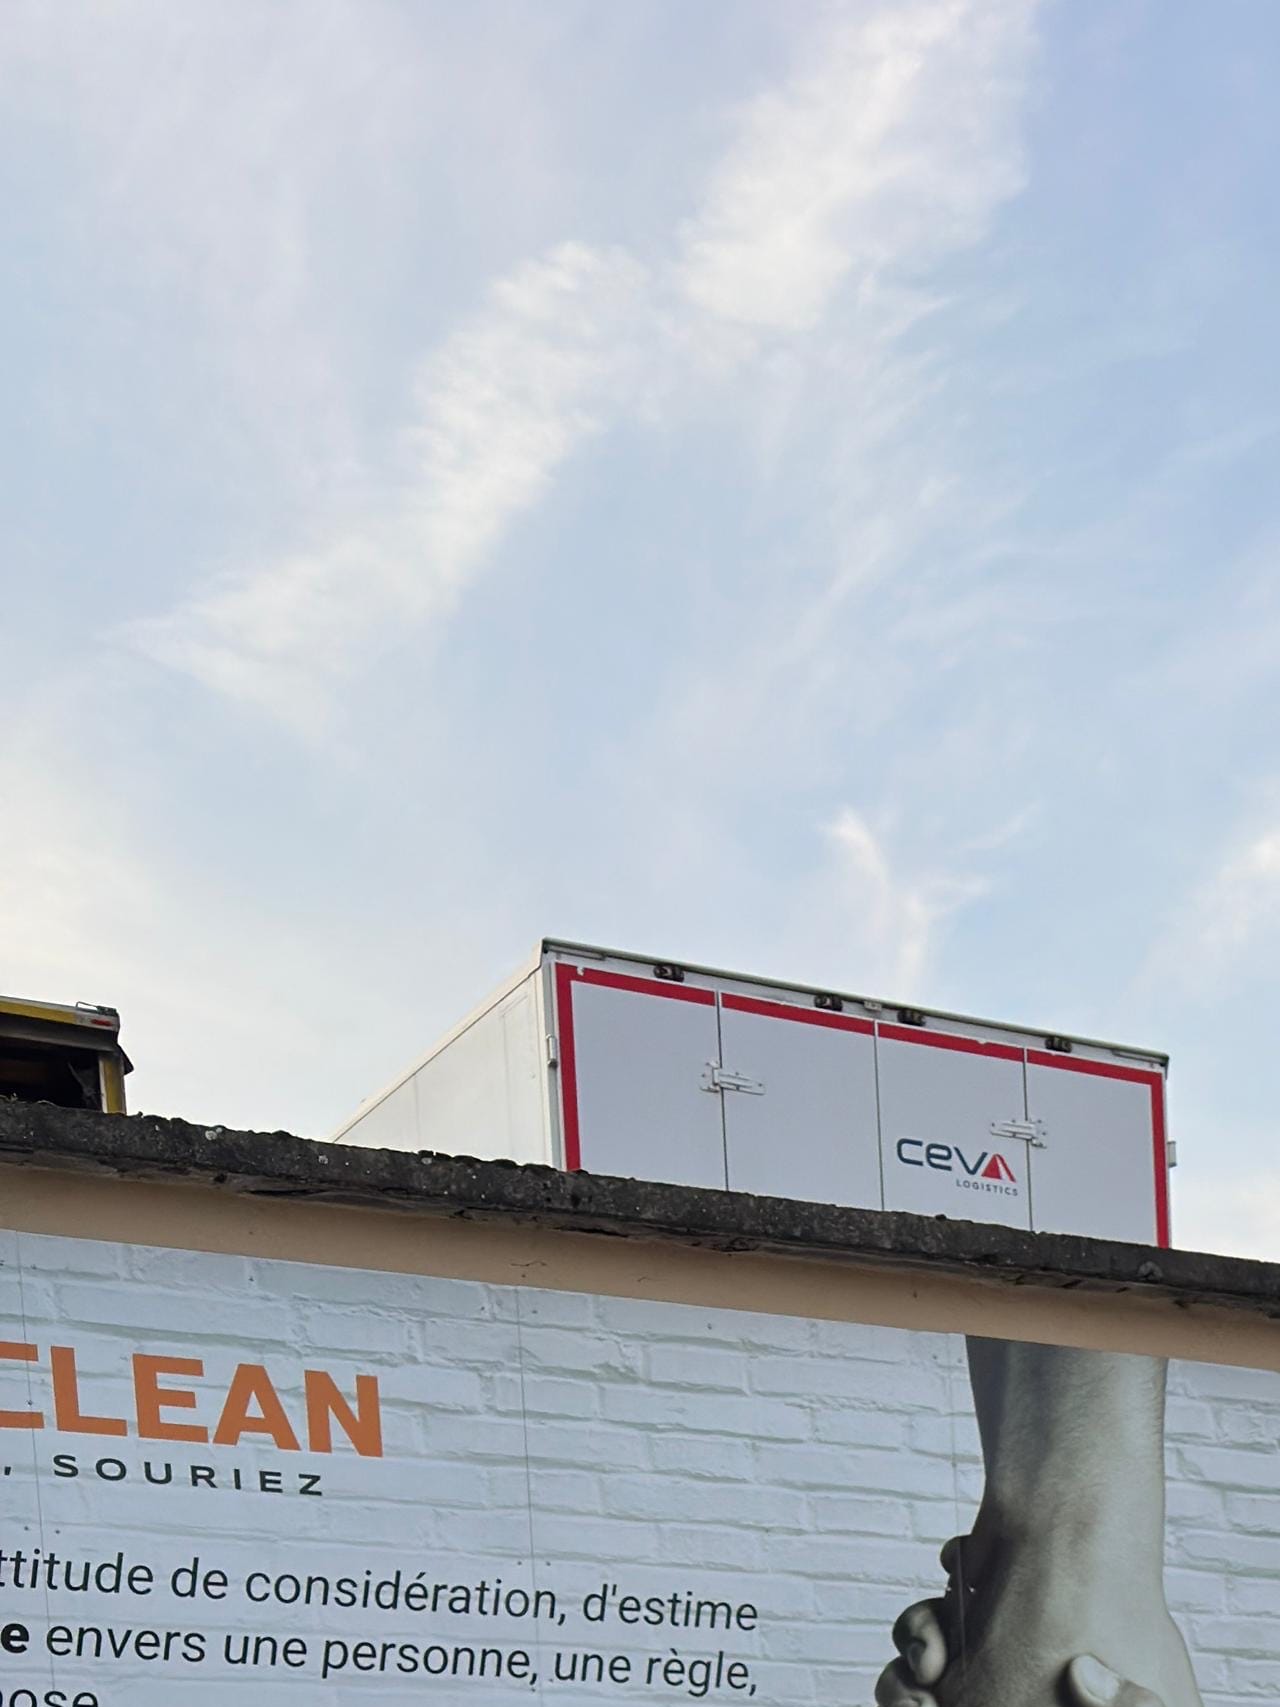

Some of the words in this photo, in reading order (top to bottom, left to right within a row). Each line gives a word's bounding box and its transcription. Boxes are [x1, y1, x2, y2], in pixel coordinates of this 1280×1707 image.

[956, 1180, 1018, 1196] LOGISTICS
[53, 1454, 323, 1496] SOURIEZ
[171, 1557, 228, 1599] de
[245, 1570, 566, 1626] considération,
[583, 1584, 758, 1632] d'estime
[47, 1624, 206, 1663] envers
[225, 1634, 308, 1667] une
[322, 1640, 538, 1686] personne,
[554, 1652, 631, 1684] une
[646, 1649, 757, 1698] règle,
